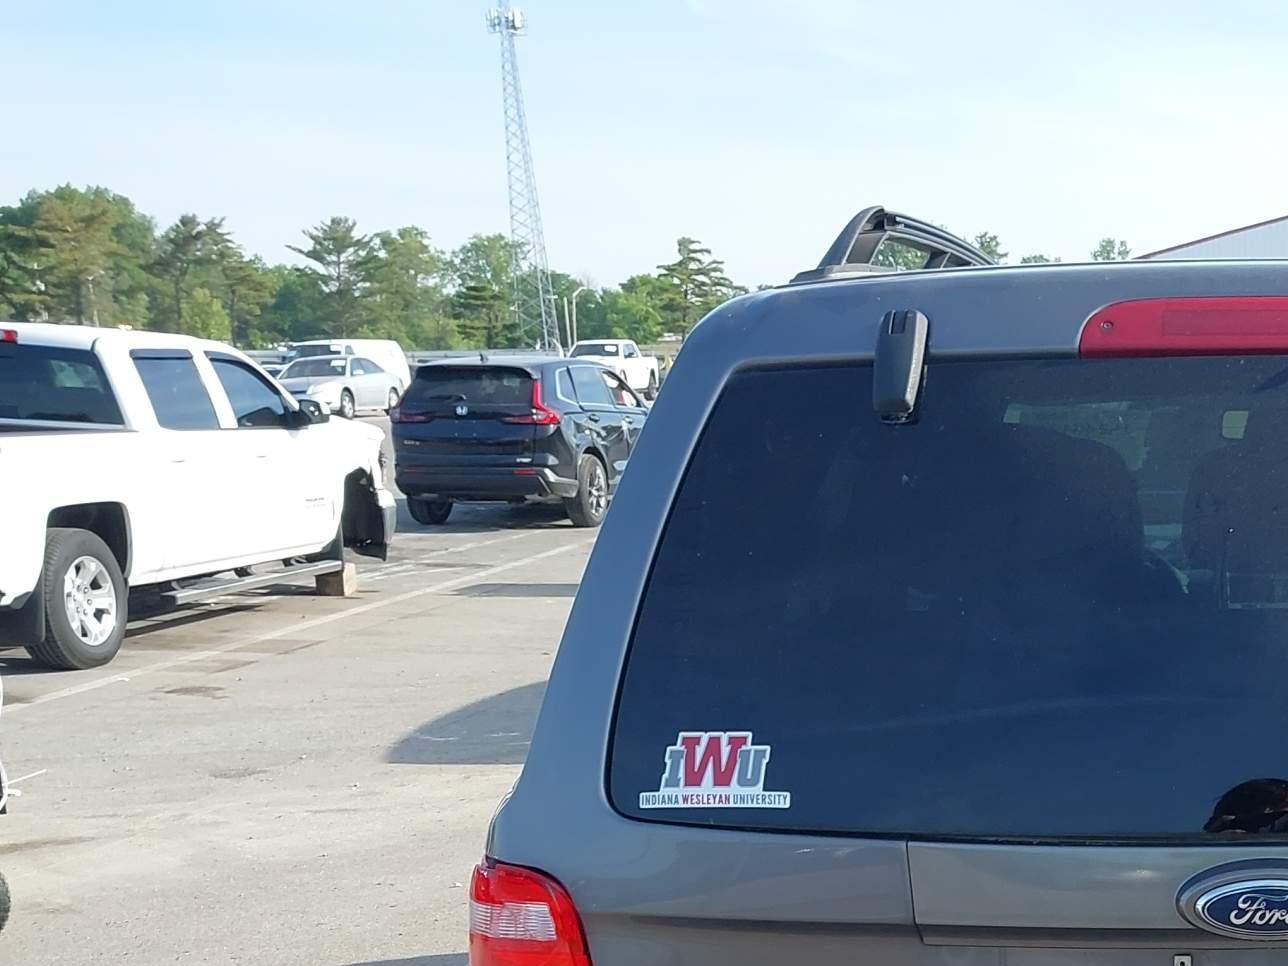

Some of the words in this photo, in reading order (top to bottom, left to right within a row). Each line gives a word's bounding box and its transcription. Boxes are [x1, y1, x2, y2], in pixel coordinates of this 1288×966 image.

[663, 736, 768, 788] IWU
[641, 794, 680, 806] INDIANA
[681, 794, 731, 805] WESLEYAN
[733, 794, 788, 806] UNIVERSITY
